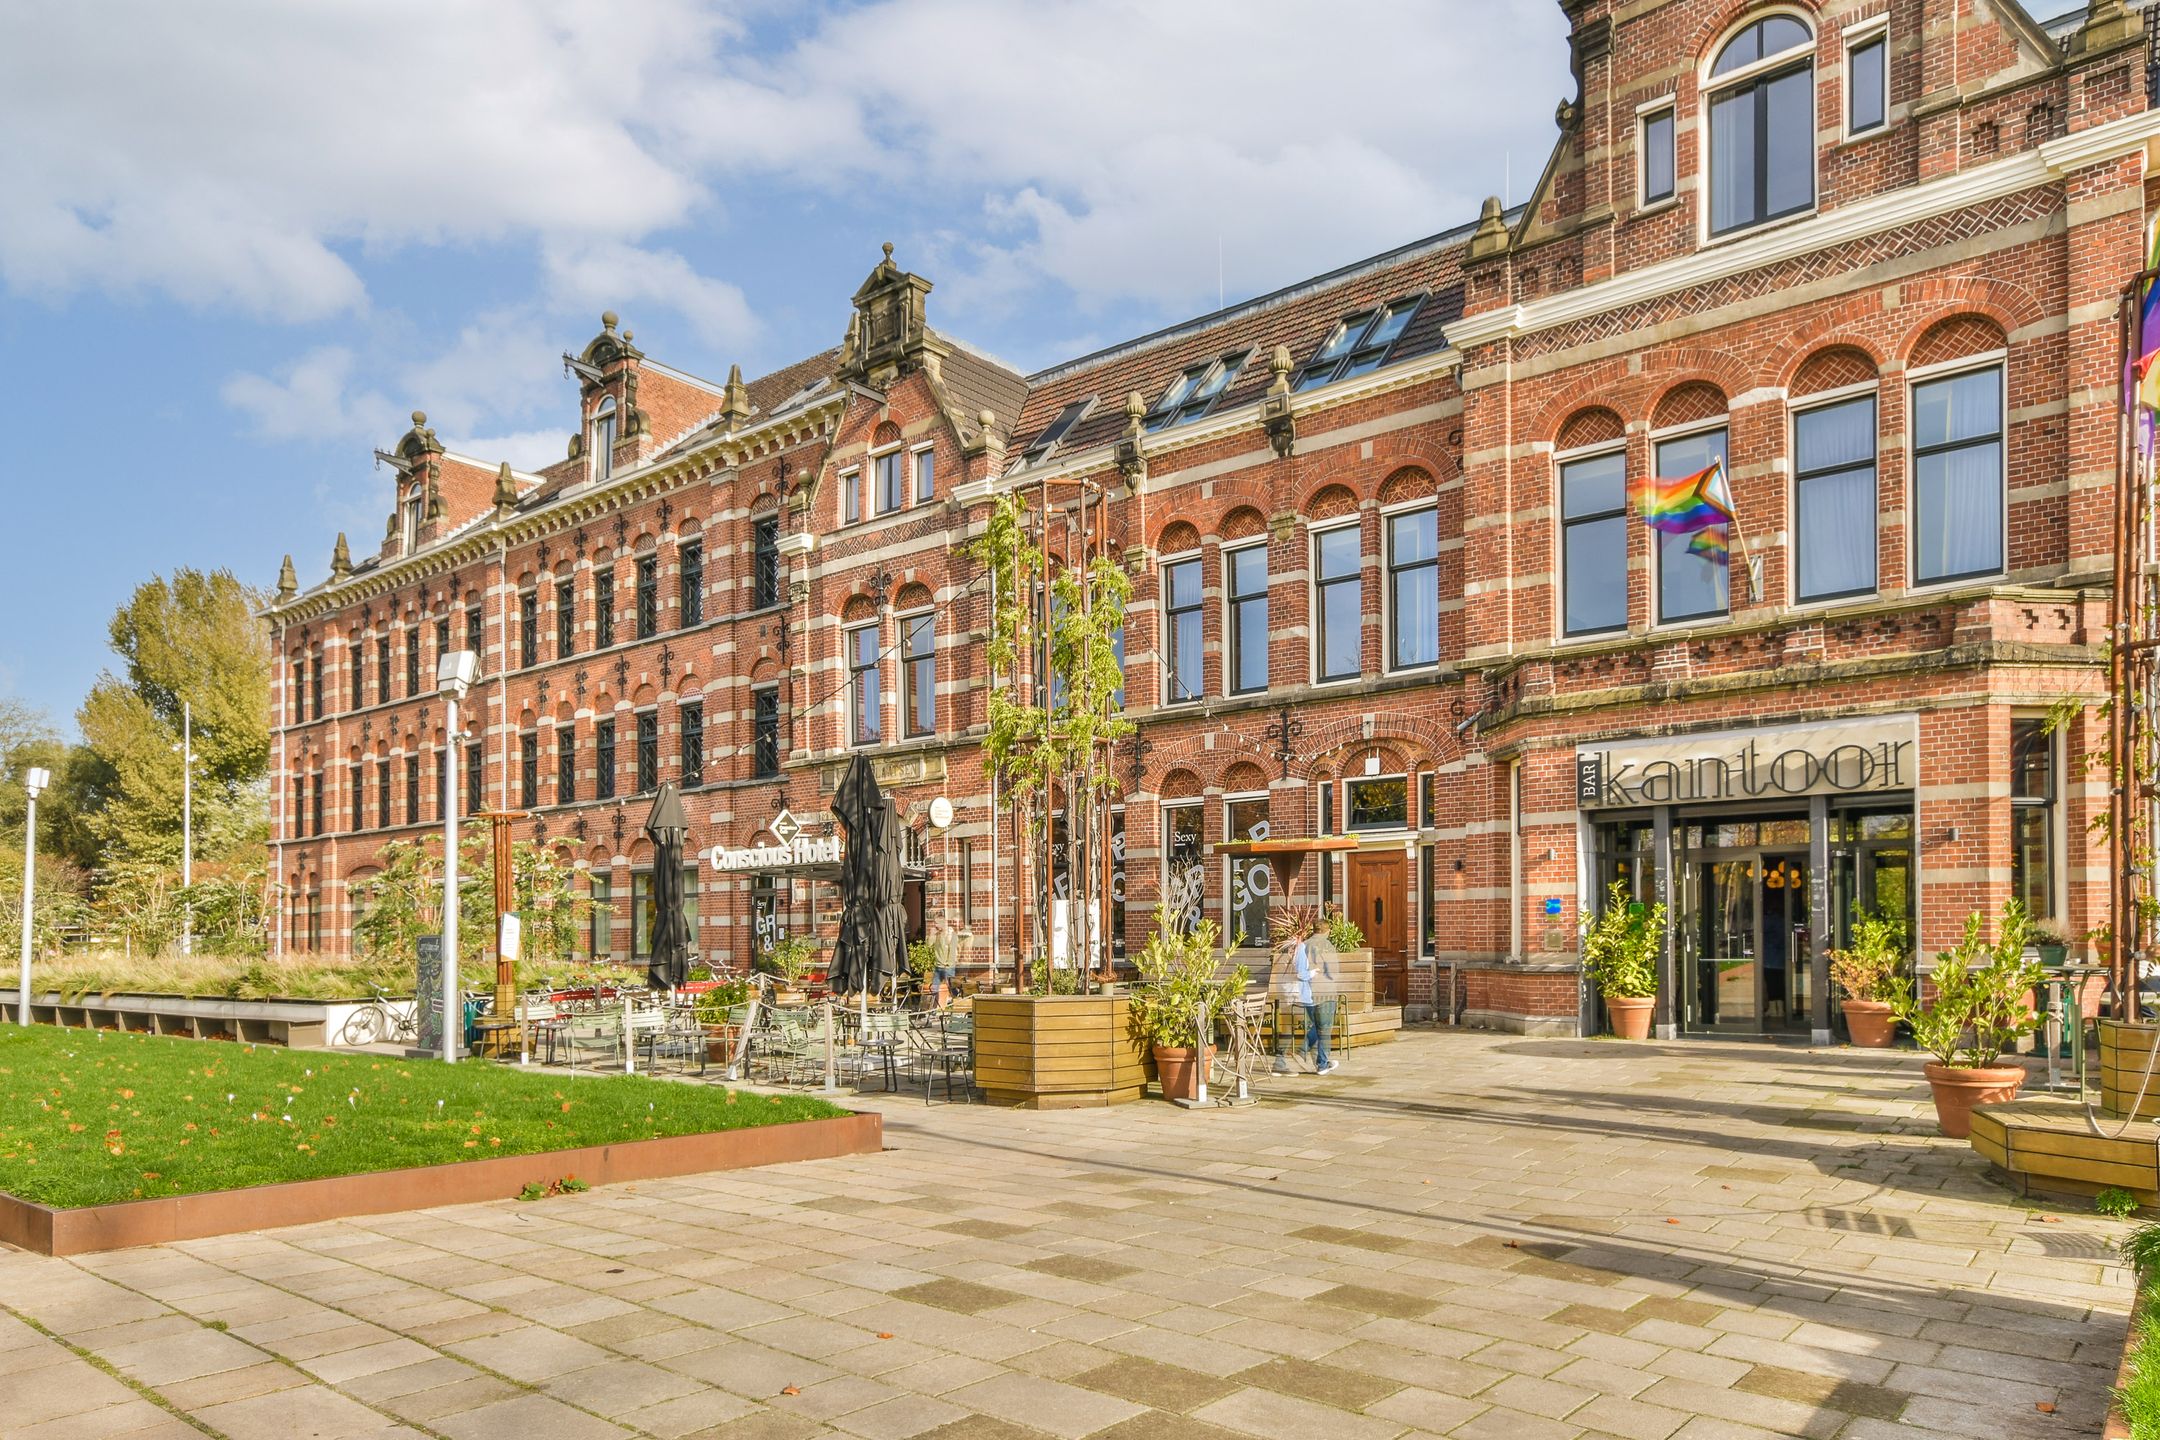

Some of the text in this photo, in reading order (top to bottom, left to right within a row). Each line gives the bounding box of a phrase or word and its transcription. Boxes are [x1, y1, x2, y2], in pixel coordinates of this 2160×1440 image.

[1582, 762, 1596, 797] BAR
[1602, 737, 1912, 806] kantoor
[711, 835, 840, 870] Conscious Hotel
[1174, 832, 1197, 844] Sexy
